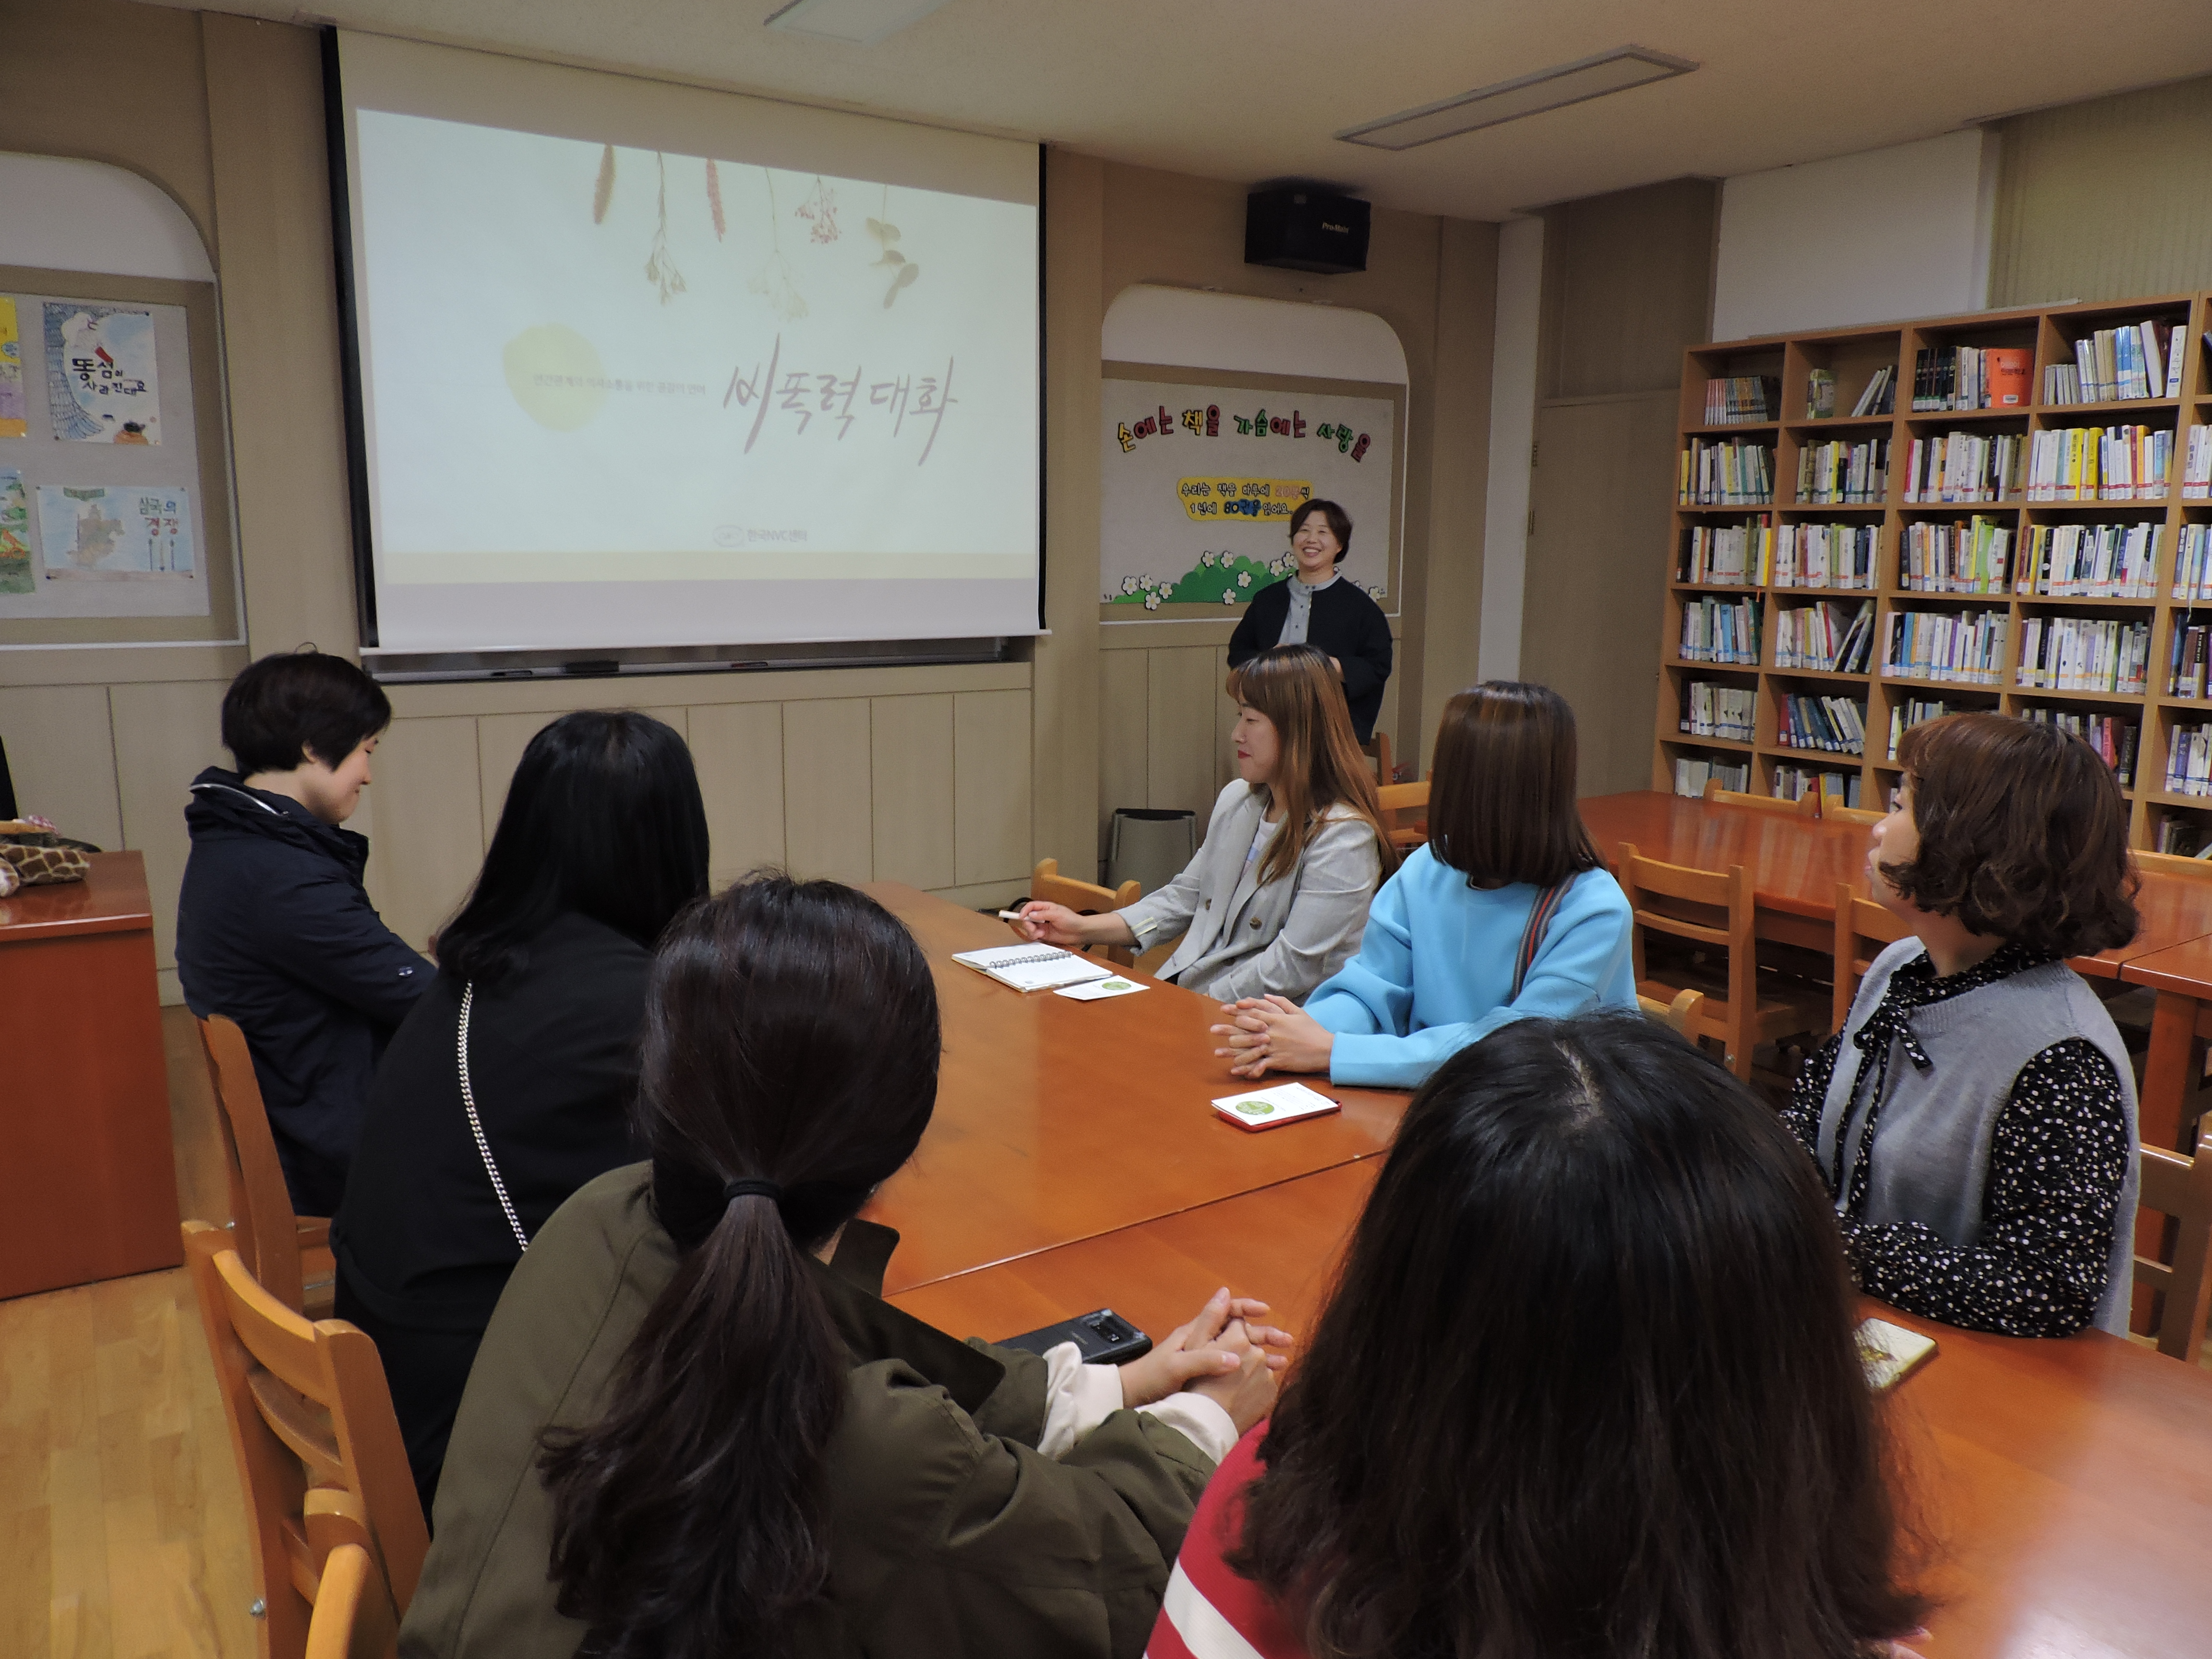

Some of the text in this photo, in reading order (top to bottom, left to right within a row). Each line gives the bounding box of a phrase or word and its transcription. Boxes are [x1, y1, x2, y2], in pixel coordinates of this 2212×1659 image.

[723, 332, 958, 466] 비폭력 대화
[1118, 405, 1371, 463] 손에는 책을 가슴에는 사랑을
[1181, 482, 1211, 497] 우리는
[1242, 483, 1270, 497] 하루에
